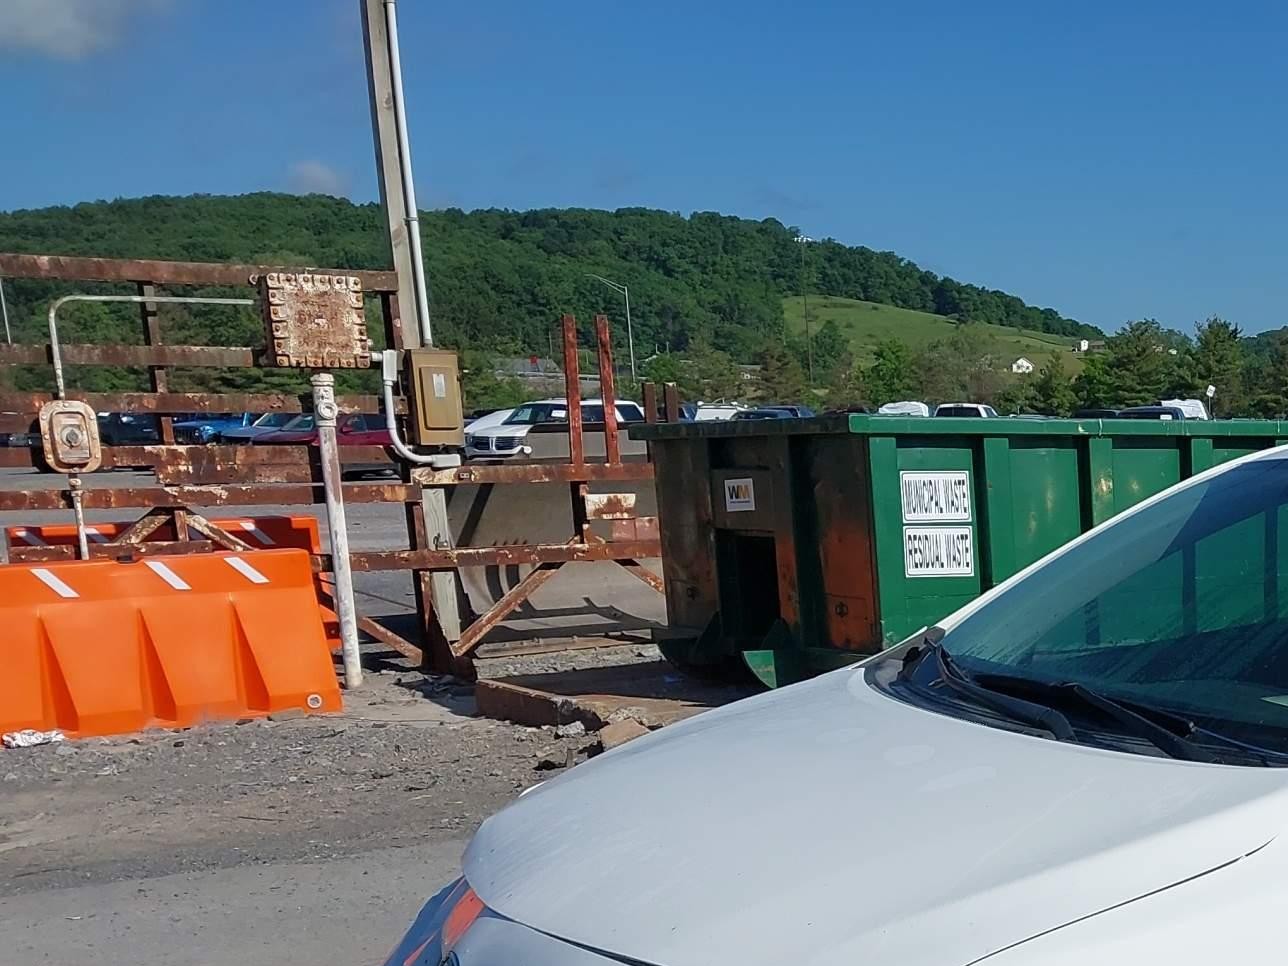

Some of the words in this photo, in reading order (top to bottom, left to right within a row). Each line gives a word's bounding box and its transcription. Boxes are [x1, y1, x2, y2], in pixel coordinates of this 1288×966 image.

[728, 484, 750, 500] WM
[904, 479, 944, 515] MUNICIPAL
[944, 479, 968, 514] WASTE
[907, 534, 945, 569] RESIDUAL
[945, 534, 970, 569] WASTE
